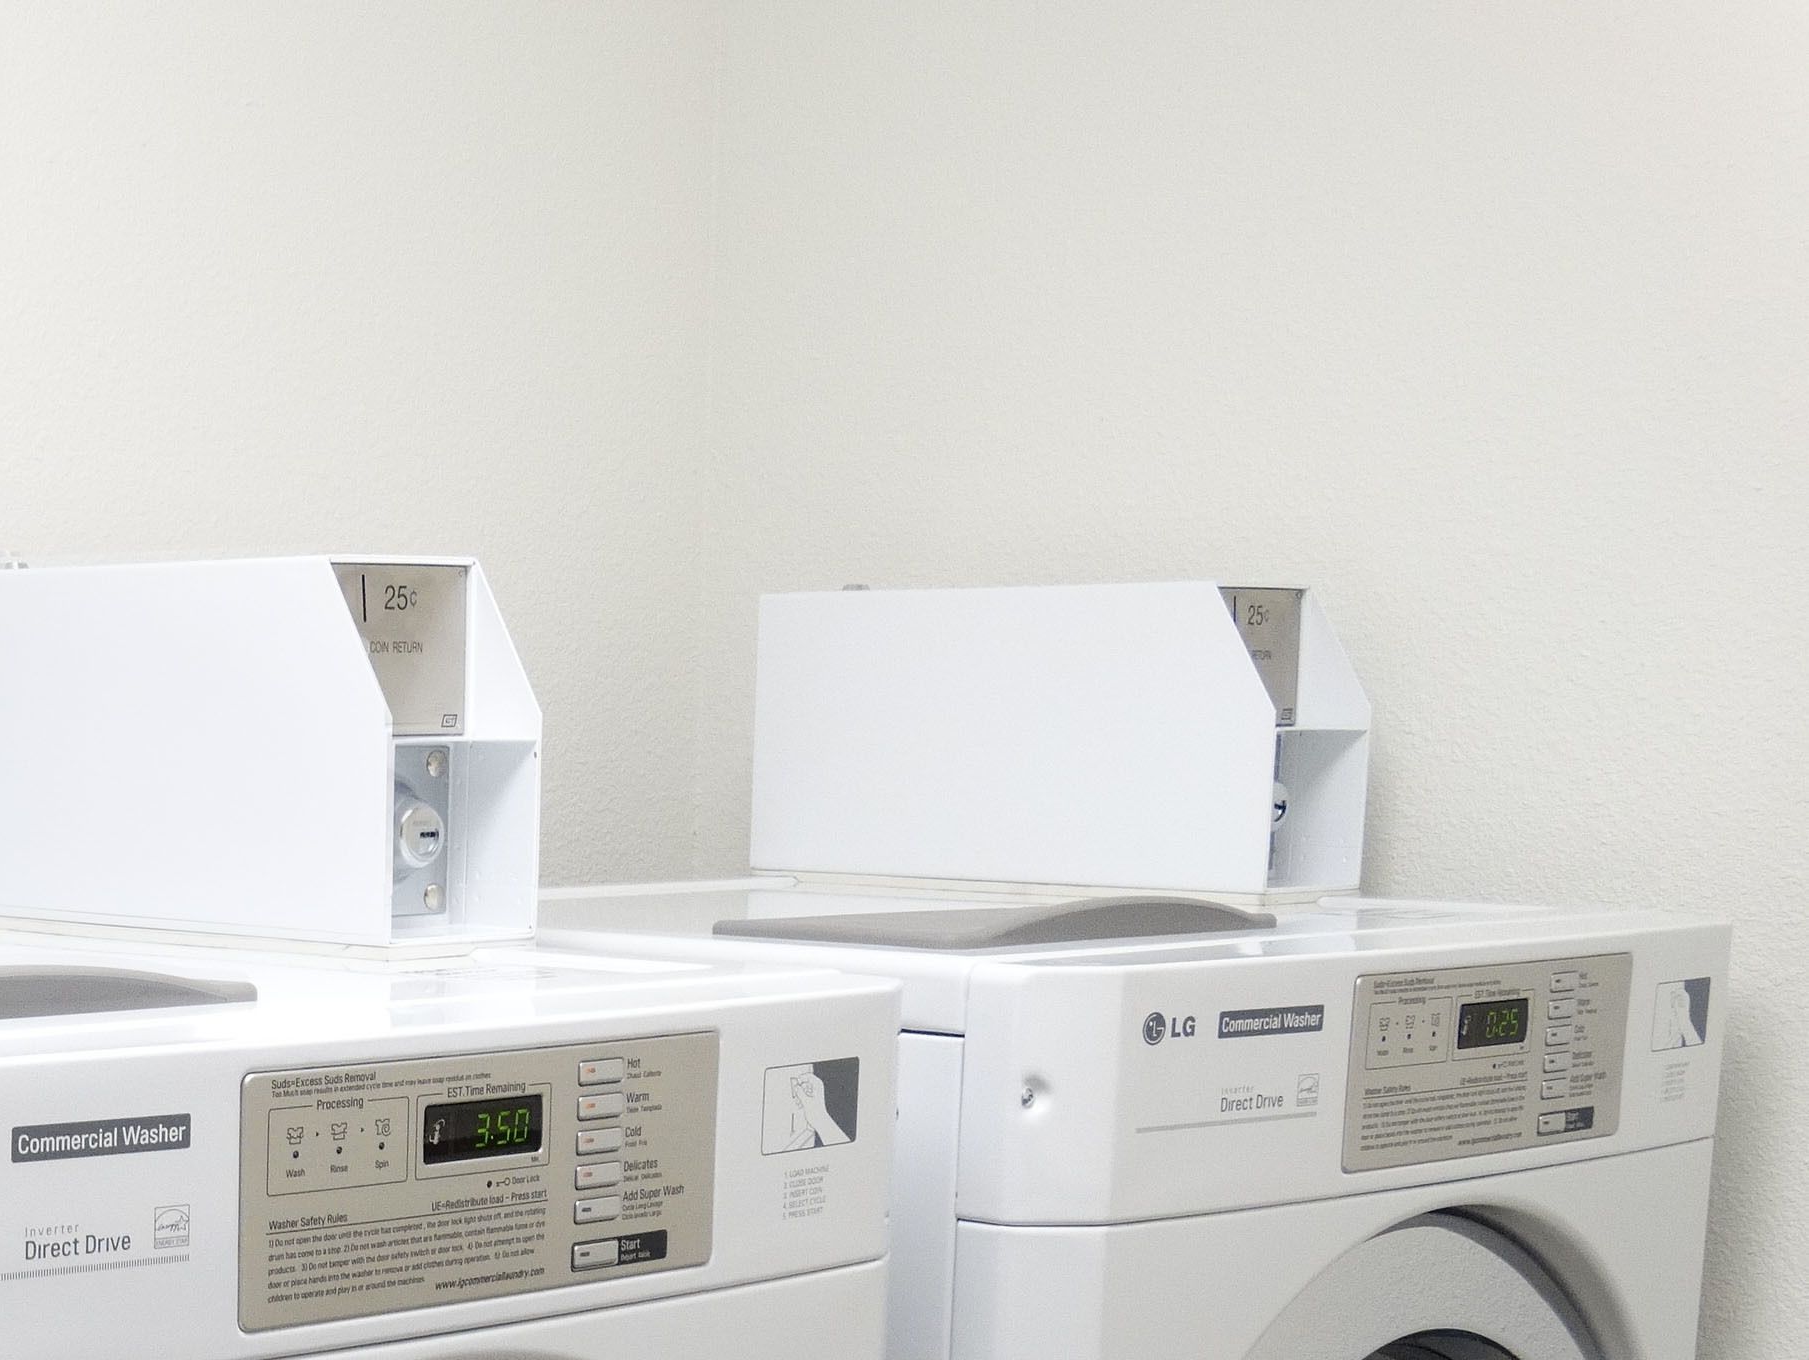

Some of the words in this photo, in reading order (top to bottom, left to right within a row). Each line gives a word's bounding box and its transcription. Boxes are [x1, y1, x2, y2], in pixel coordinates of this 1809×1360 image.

[385, 585, 417, 610] 25¢
[370, 641, 389, 653] COIN
[393, 641, 422, 653] RETURN
[1171, 1016, 1196, 1037] LG
[1222, 1014, 1281, 1033] Commercial
[1284, 1012, 1322, 1028] Washer
[627, 1058, 640, 1069] Hot
[486, 1082, 526, 1095] Remaining
[316, 1096, 363, 1110] Processing
[626, 1092, 649, 1103] Warm
[1221, 1096, 1253, 1112] Direct
[1256, 1094, 1283, 1110] Drive
[625, 1126, 642, 1137] Cold
[18, 1129, 117, 1155] Commercial
[123, 1123, 186, 1147] Washer
[330, 1164, 348, 1174] Rinse
[375, 1159, 389, 1169] Spin
[624, 1159, 658, 1172] Delicates
[286, 1168, 305, 1178] Wash
[623, 1191, 638, 1201] Add
[640, 1188, 662, 1200] Super
[663, 1185, 684, 1197] Wash
[268, 1219, 298, 1230] Washer
[300, 1216, 325, 1227] Safety
[326, 1213, 347, 1223] Rules
[25, 1238, 79, 1260] Direct
[85, 1235, 131, 1254] Drive
[621, 1239, 640, 1251] Start
